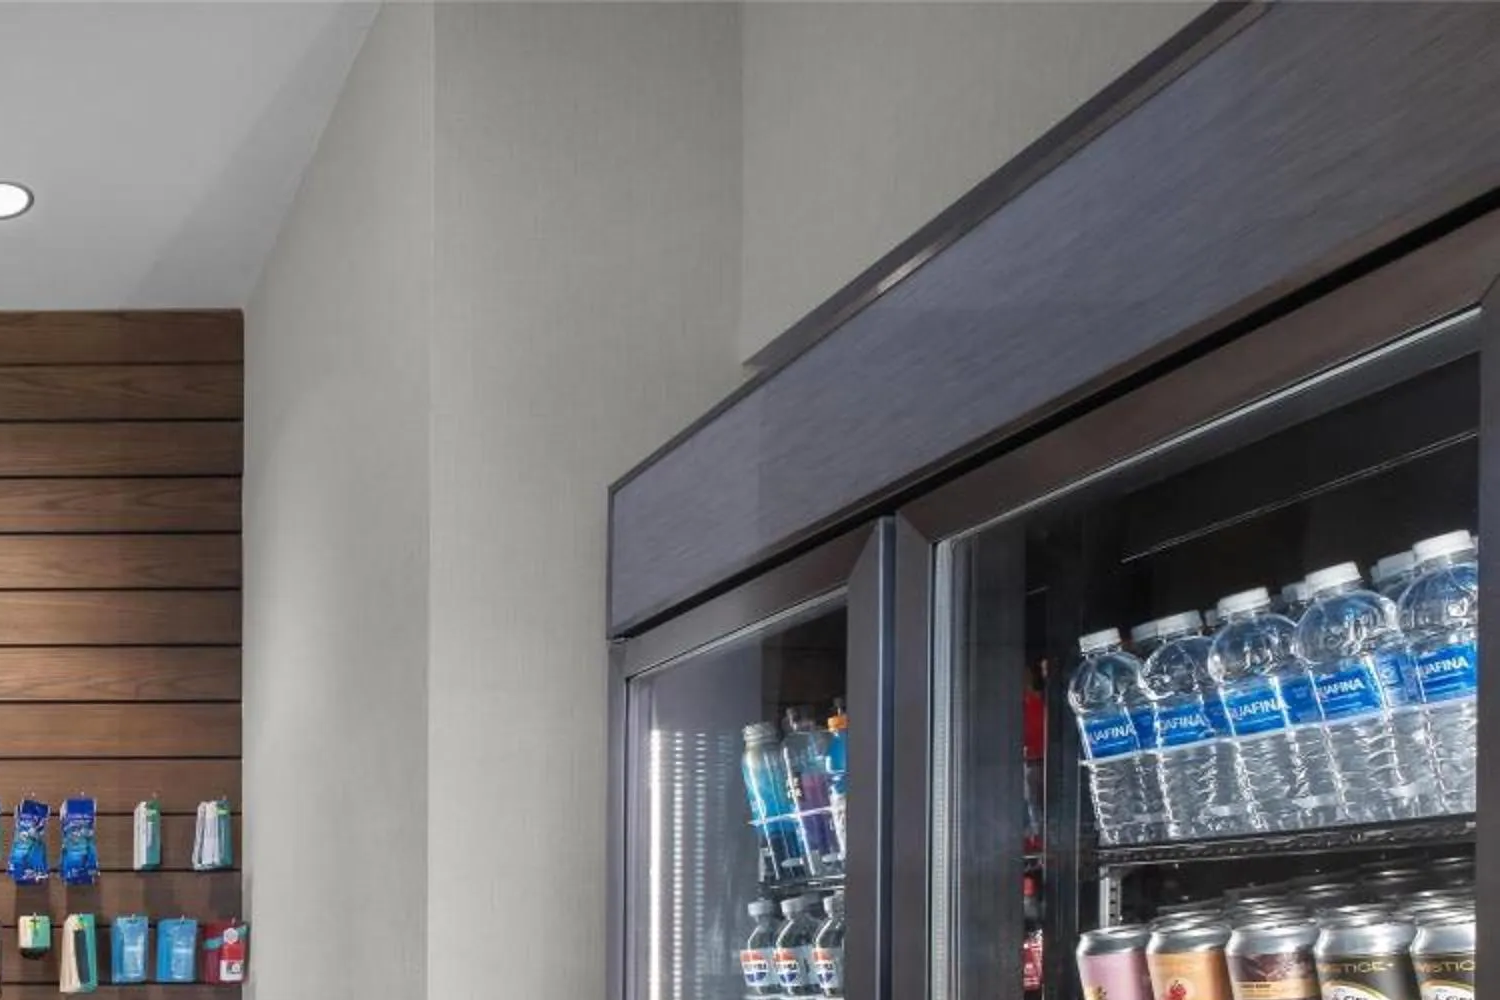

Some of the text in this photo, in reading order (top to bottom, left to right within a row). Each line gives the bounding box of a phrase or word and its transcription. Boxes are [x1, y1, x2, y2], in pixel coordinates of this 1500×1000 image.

[1421, 655, 1469, 676] UAFINA
[1317, 677, 1365, 699] UAFINA
[1088, 722, 1136, 744] UAFINA
